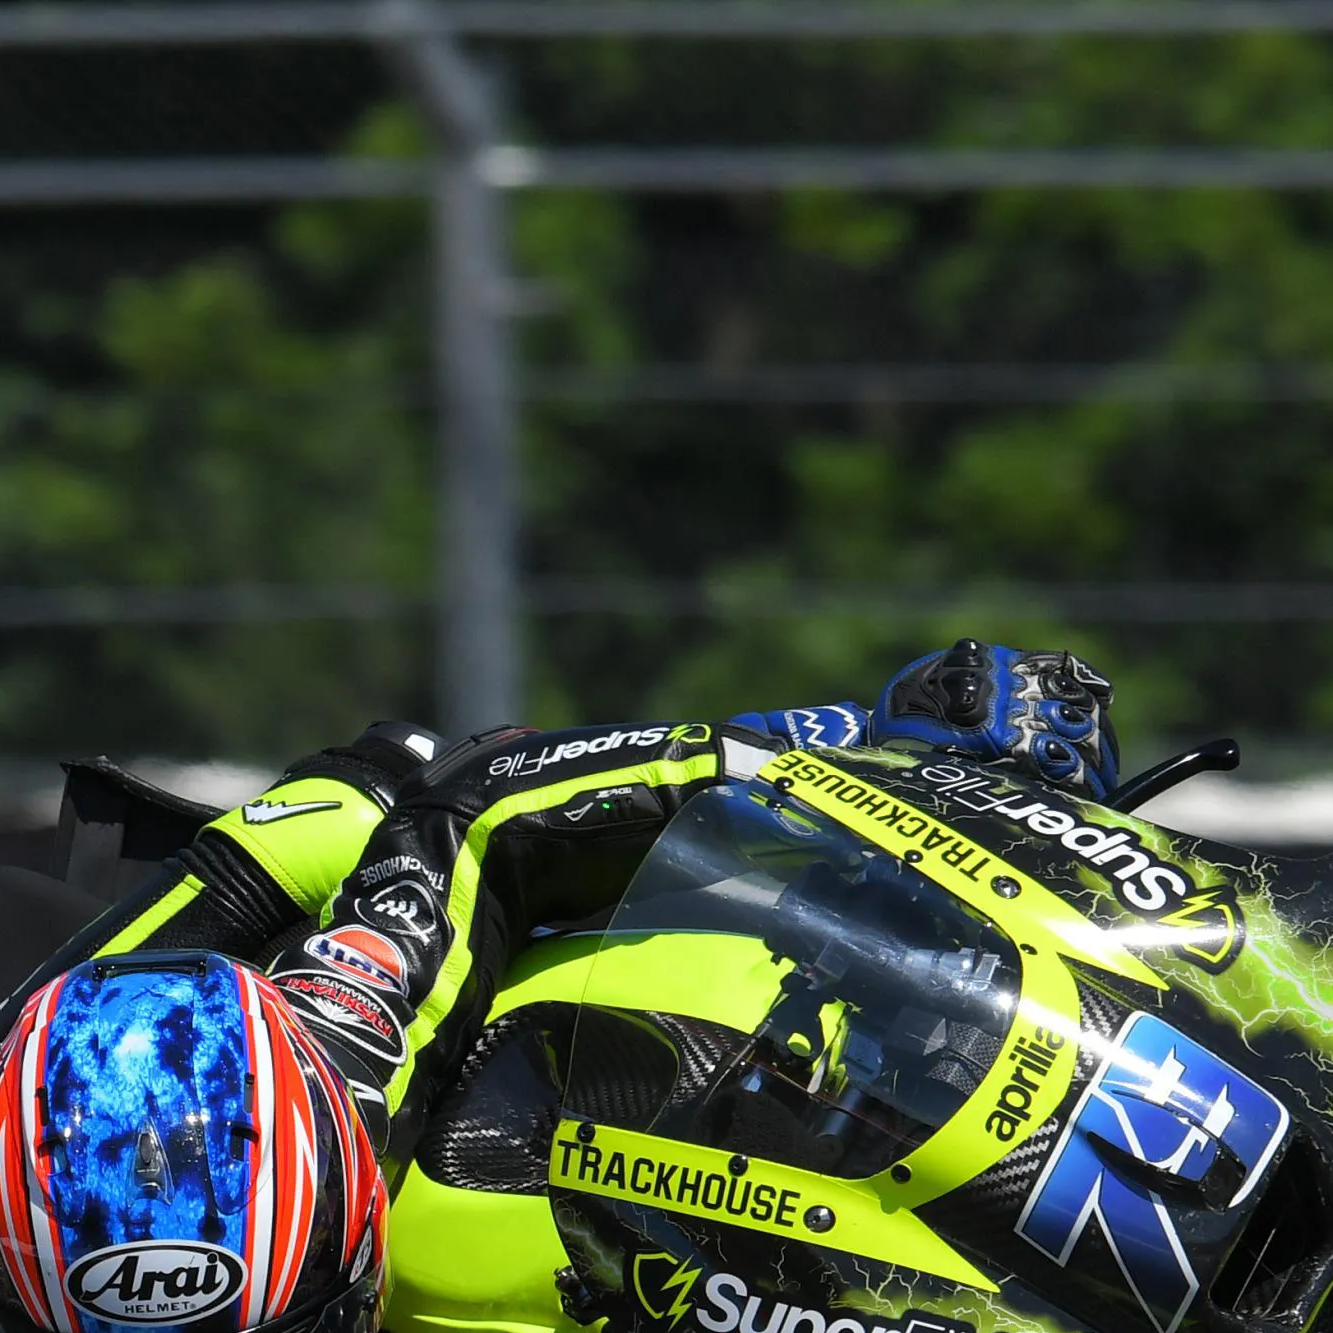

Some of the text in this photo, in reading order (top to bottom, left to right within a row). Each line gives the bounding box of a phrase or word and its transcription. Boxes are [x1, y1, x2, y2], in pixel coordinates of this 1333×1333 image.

[488, 726, 669, 778] SuperFile
[769, 753, 996, 884] TRACKHOUSE
[919, 762, 1186, 912] SuperFile
[985, 1025, 1066, 1143] aprilia
[557, 1138, 804, 1229] TRACKHOUSE
[81, 1252, 224, 1302] Arai
[124, 1300, 190, 1314] HELMET
